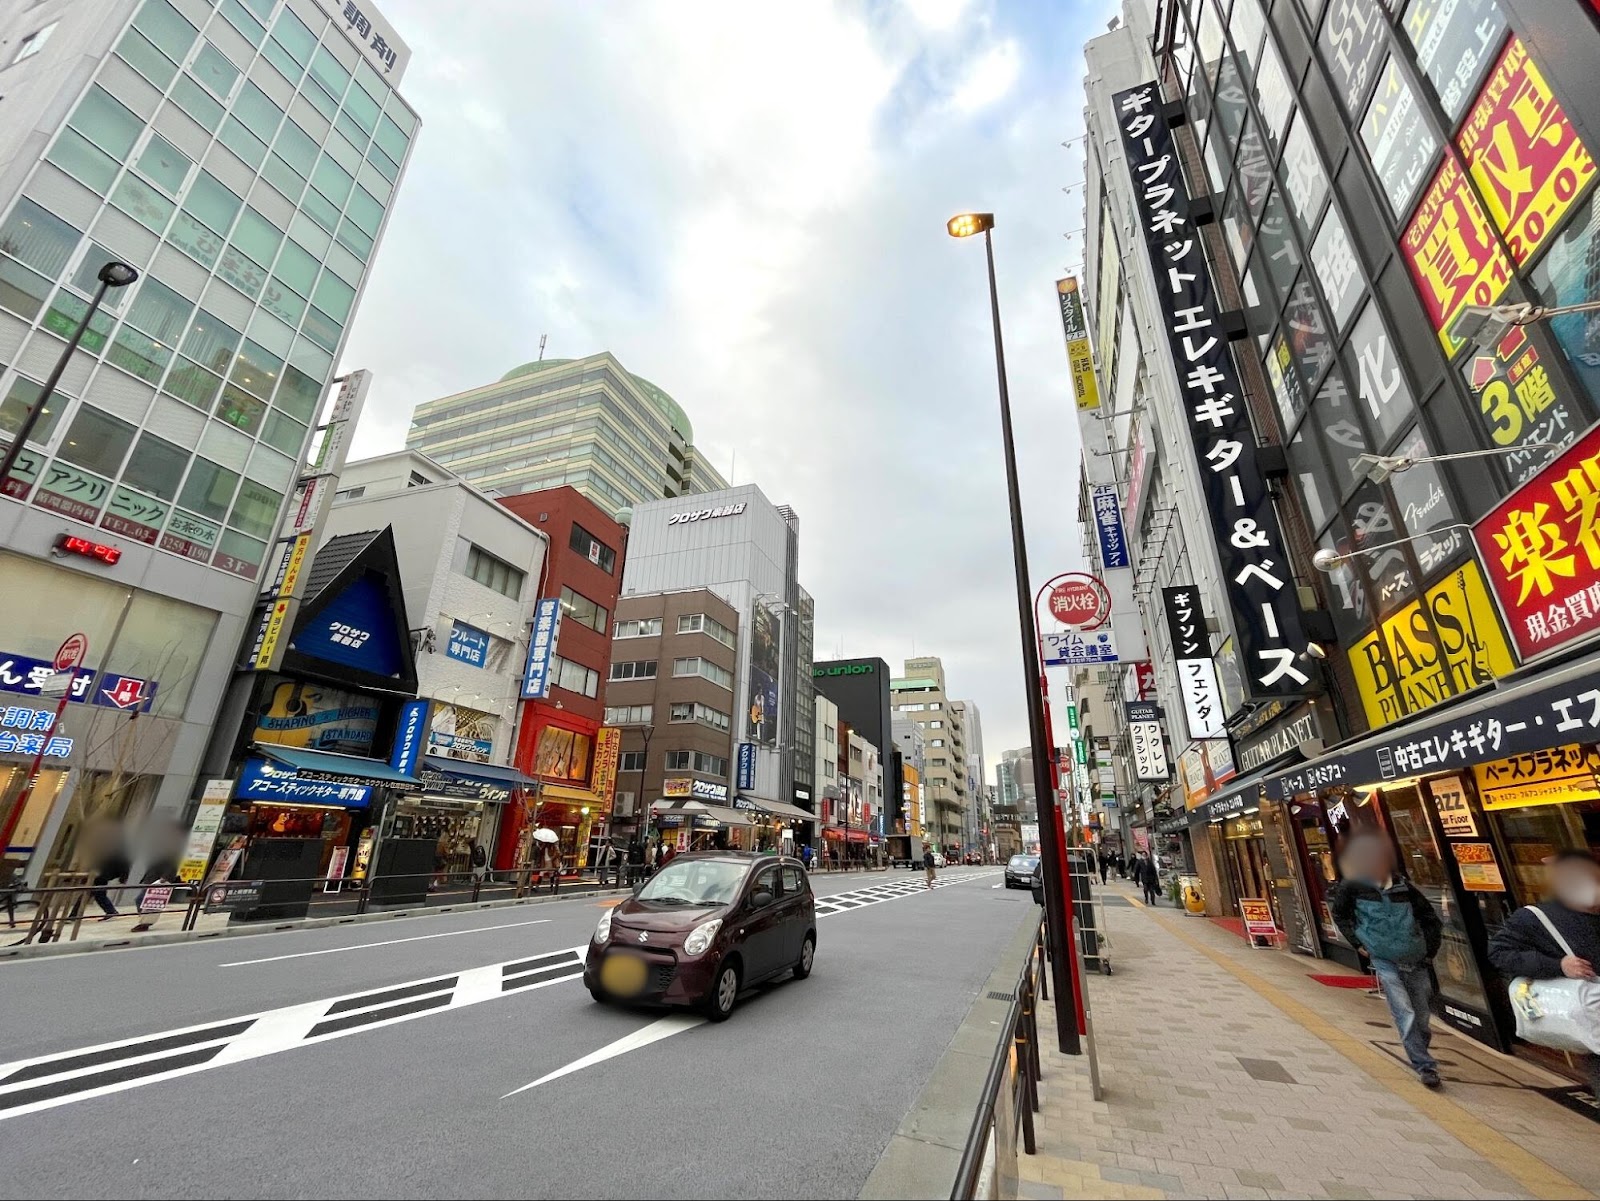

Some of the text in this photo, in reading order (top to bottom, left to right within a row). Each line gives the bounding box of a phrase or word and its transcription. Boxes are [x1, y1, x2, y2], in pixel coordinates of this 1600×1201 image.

[335, 0, 397, 70] 調剤
[1122, 87, 1197, 294] ギタープラネット
[1481, 365, 1556, 446] 3階
[1094, 486, 1112, 494] 4F
[1173, 306, 1310, 688] エレキギター&ベース
[668, 502, 747, 526] クロサワ楽器店
[1096, 495, 1119, 526] 麻雀
[1403, 483, 1446, 530] Fender
[170, 517, 214, 541] お茶の水
[222, 556, 248, 573] 3F
[1053, 592, 1096, 613] 消火栓
[329, 621, 371, 640] クロサワ
[450, 627, 486, 649] フルート
[1048, 634, 1084, 646] ワイム
[450, 641, 481, 662] 専門店
[1058, 644, 1114, 658] 貸会議室
[1363, 591, 1465, 695] BASS
[827, 664, 874, 677] union
[0, 731, 73, 758] 台薬局
[1134, 725, 1149, 775] クラシック
[1148, 725, 1165, 775] ウクレレ
